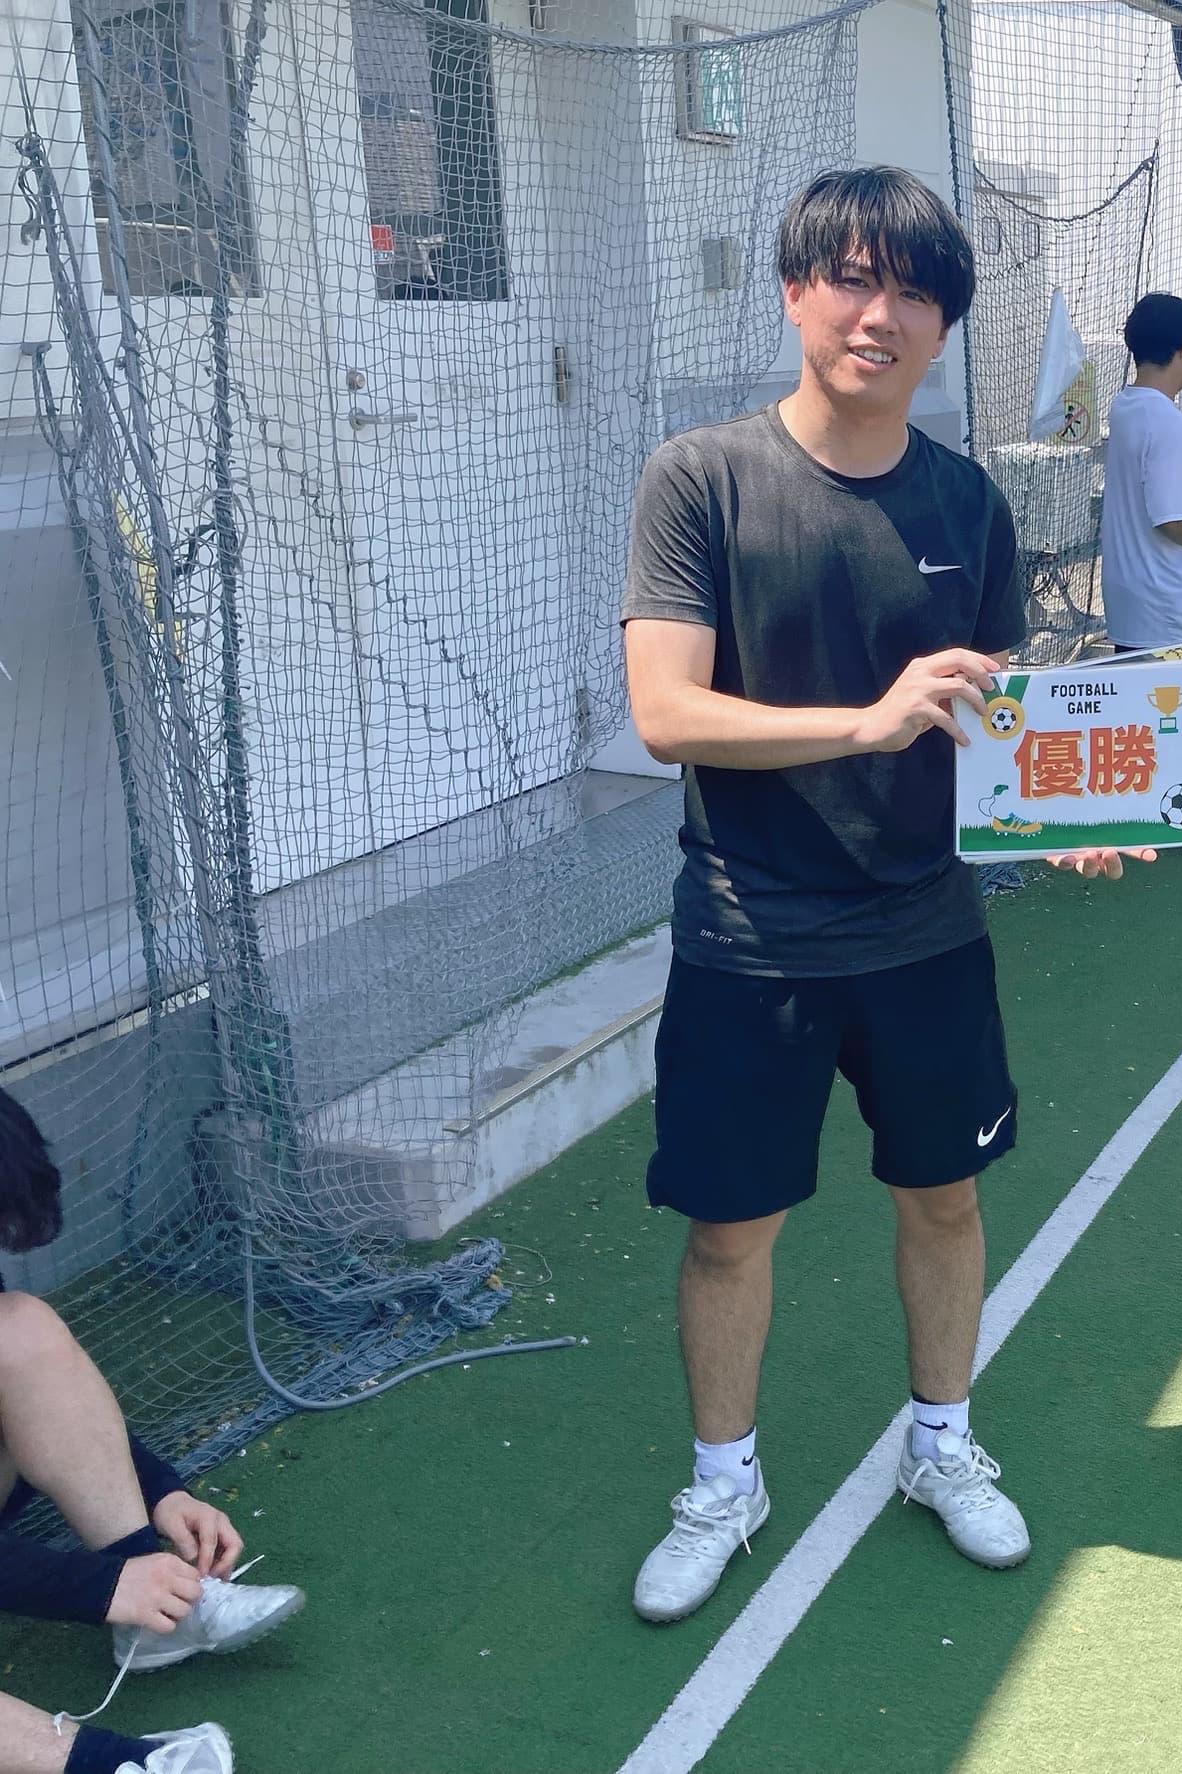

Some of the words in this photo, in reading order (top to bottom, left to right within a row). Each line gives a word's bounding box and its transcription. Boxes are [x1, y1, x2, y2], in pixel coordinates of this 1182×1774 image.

[1051, 683, 1118, 698] FOOTBALL
[1067, 701, 1102, 714] GAME
[1013, 724, 1158, 799] 優勝
[699, 928, 733, 945] DRI-FIT
